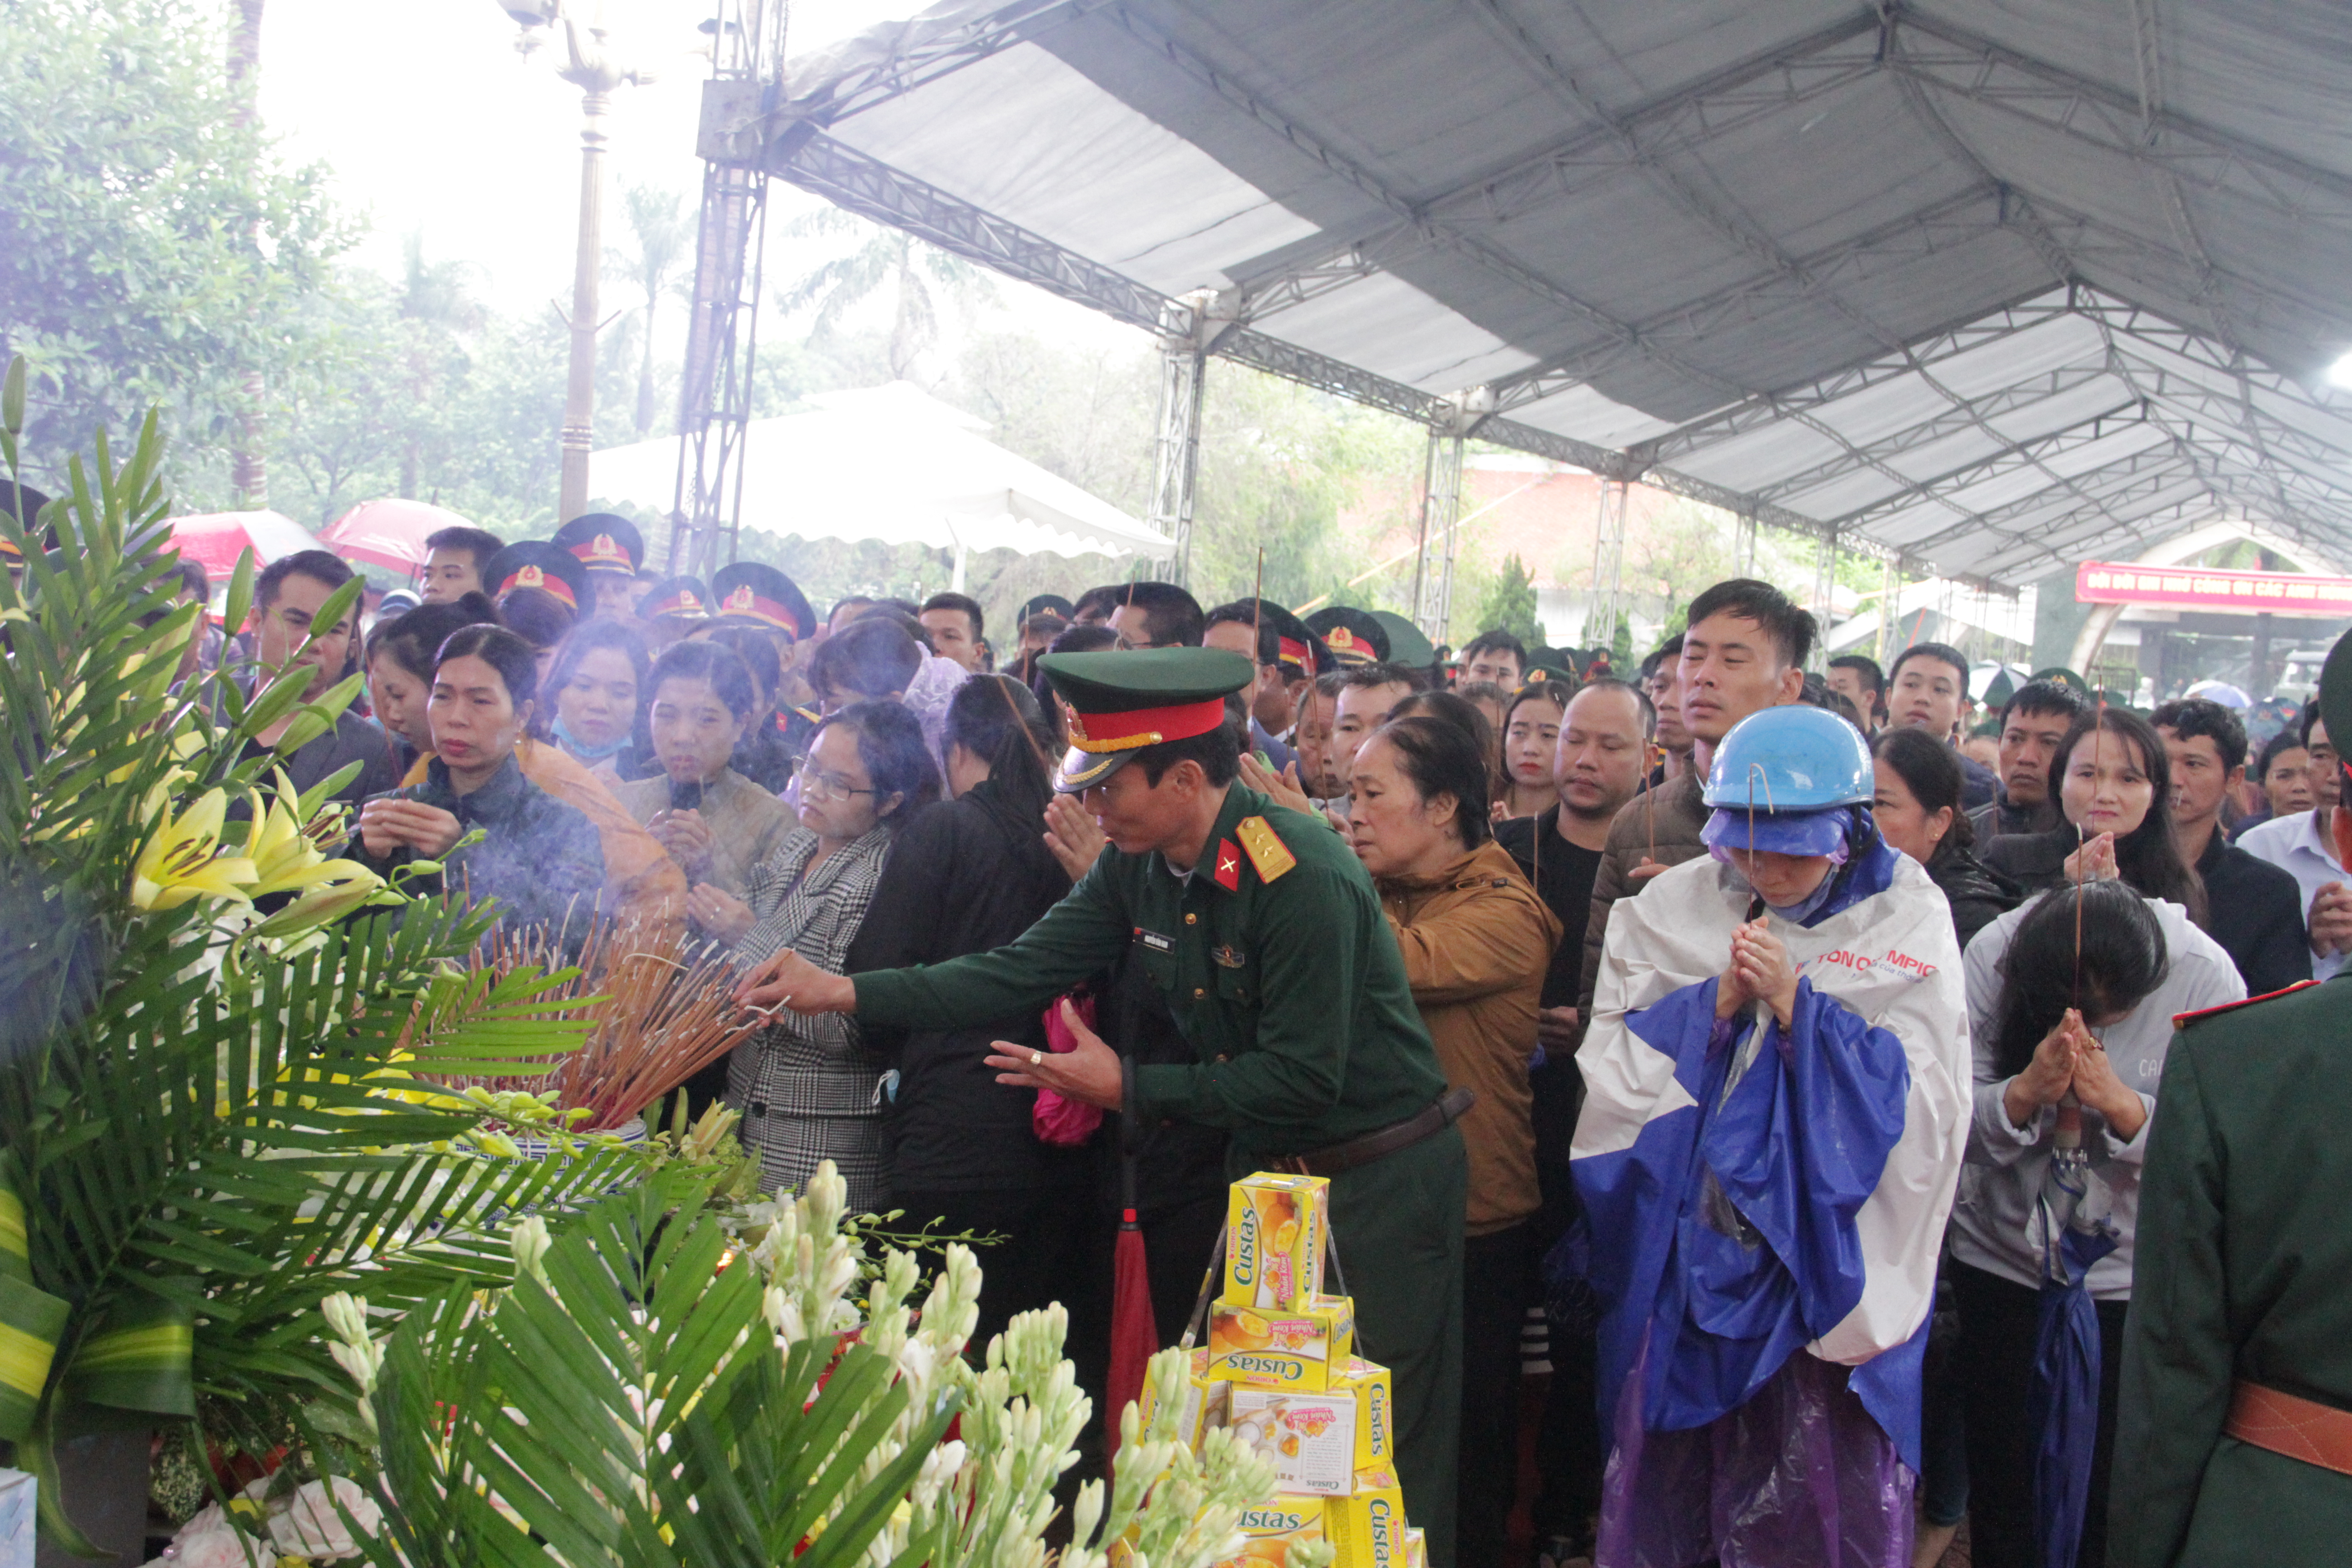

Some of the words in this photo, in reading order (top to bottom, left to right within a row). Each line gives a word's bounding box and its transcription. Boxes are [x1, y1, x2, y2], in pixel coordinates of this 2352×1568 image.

[1234, 1206, 1255, 1286] Custas
[1227, 1354, 1303, 1380] Custas
[1247, 1375, 1271, 1383] ORION
[1370, 1383, 1384, 1456] Custas
[1306, 1480, 1339, 1490] Custas
[1237, 1509, 1301, 1529] ustas
